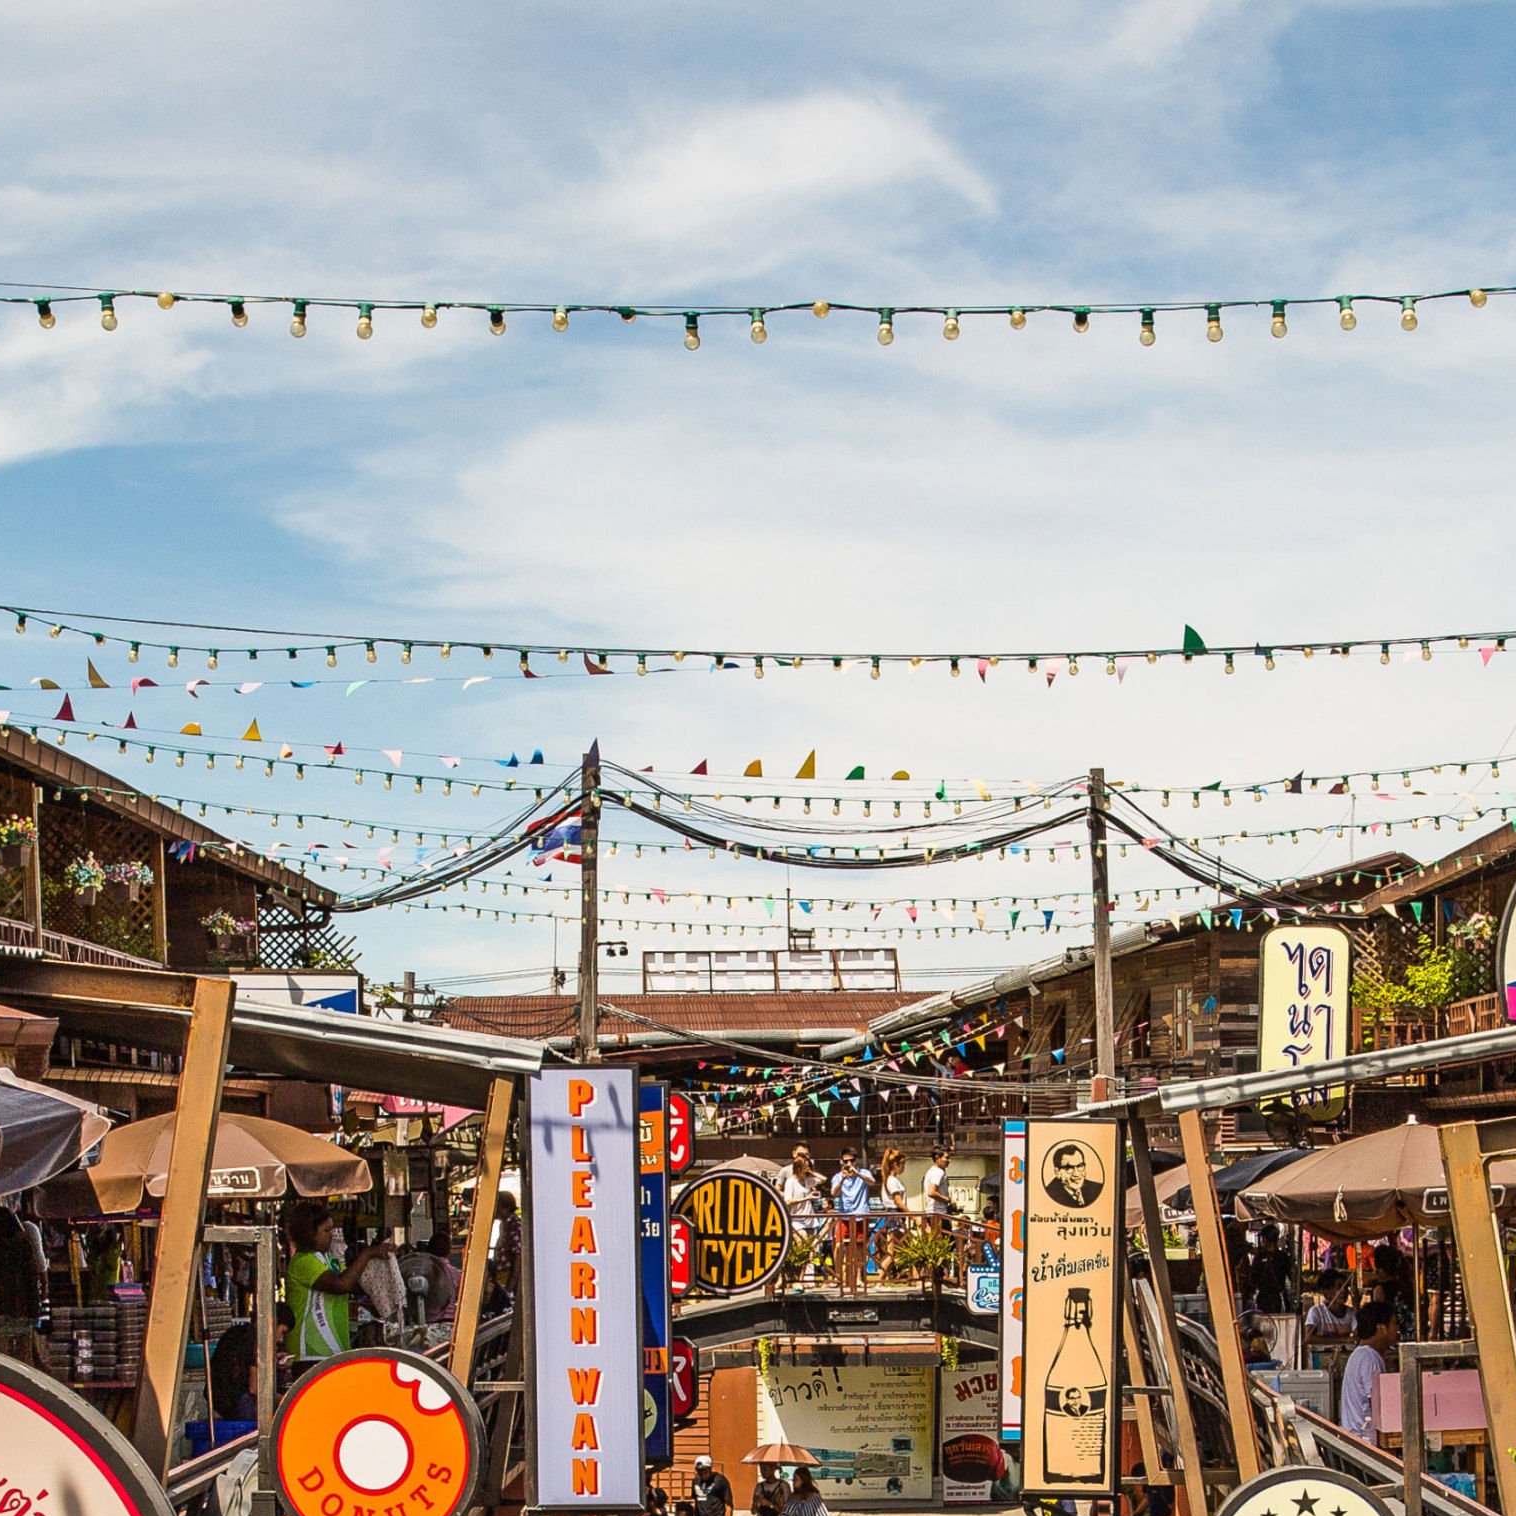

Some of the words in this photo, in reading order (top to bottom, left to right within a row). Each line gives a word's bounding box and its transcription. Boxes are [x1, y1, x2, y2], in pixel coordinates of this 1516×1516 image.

[568, 1078, 598, 1347] PLEARN
[727, 1178, 762, 1237] ON
[764, 1200, 783, 1237] A
[1056, 1222, 1112, 1241] ลุงแว่น
[567, 1367, 602, 1498] WAN
